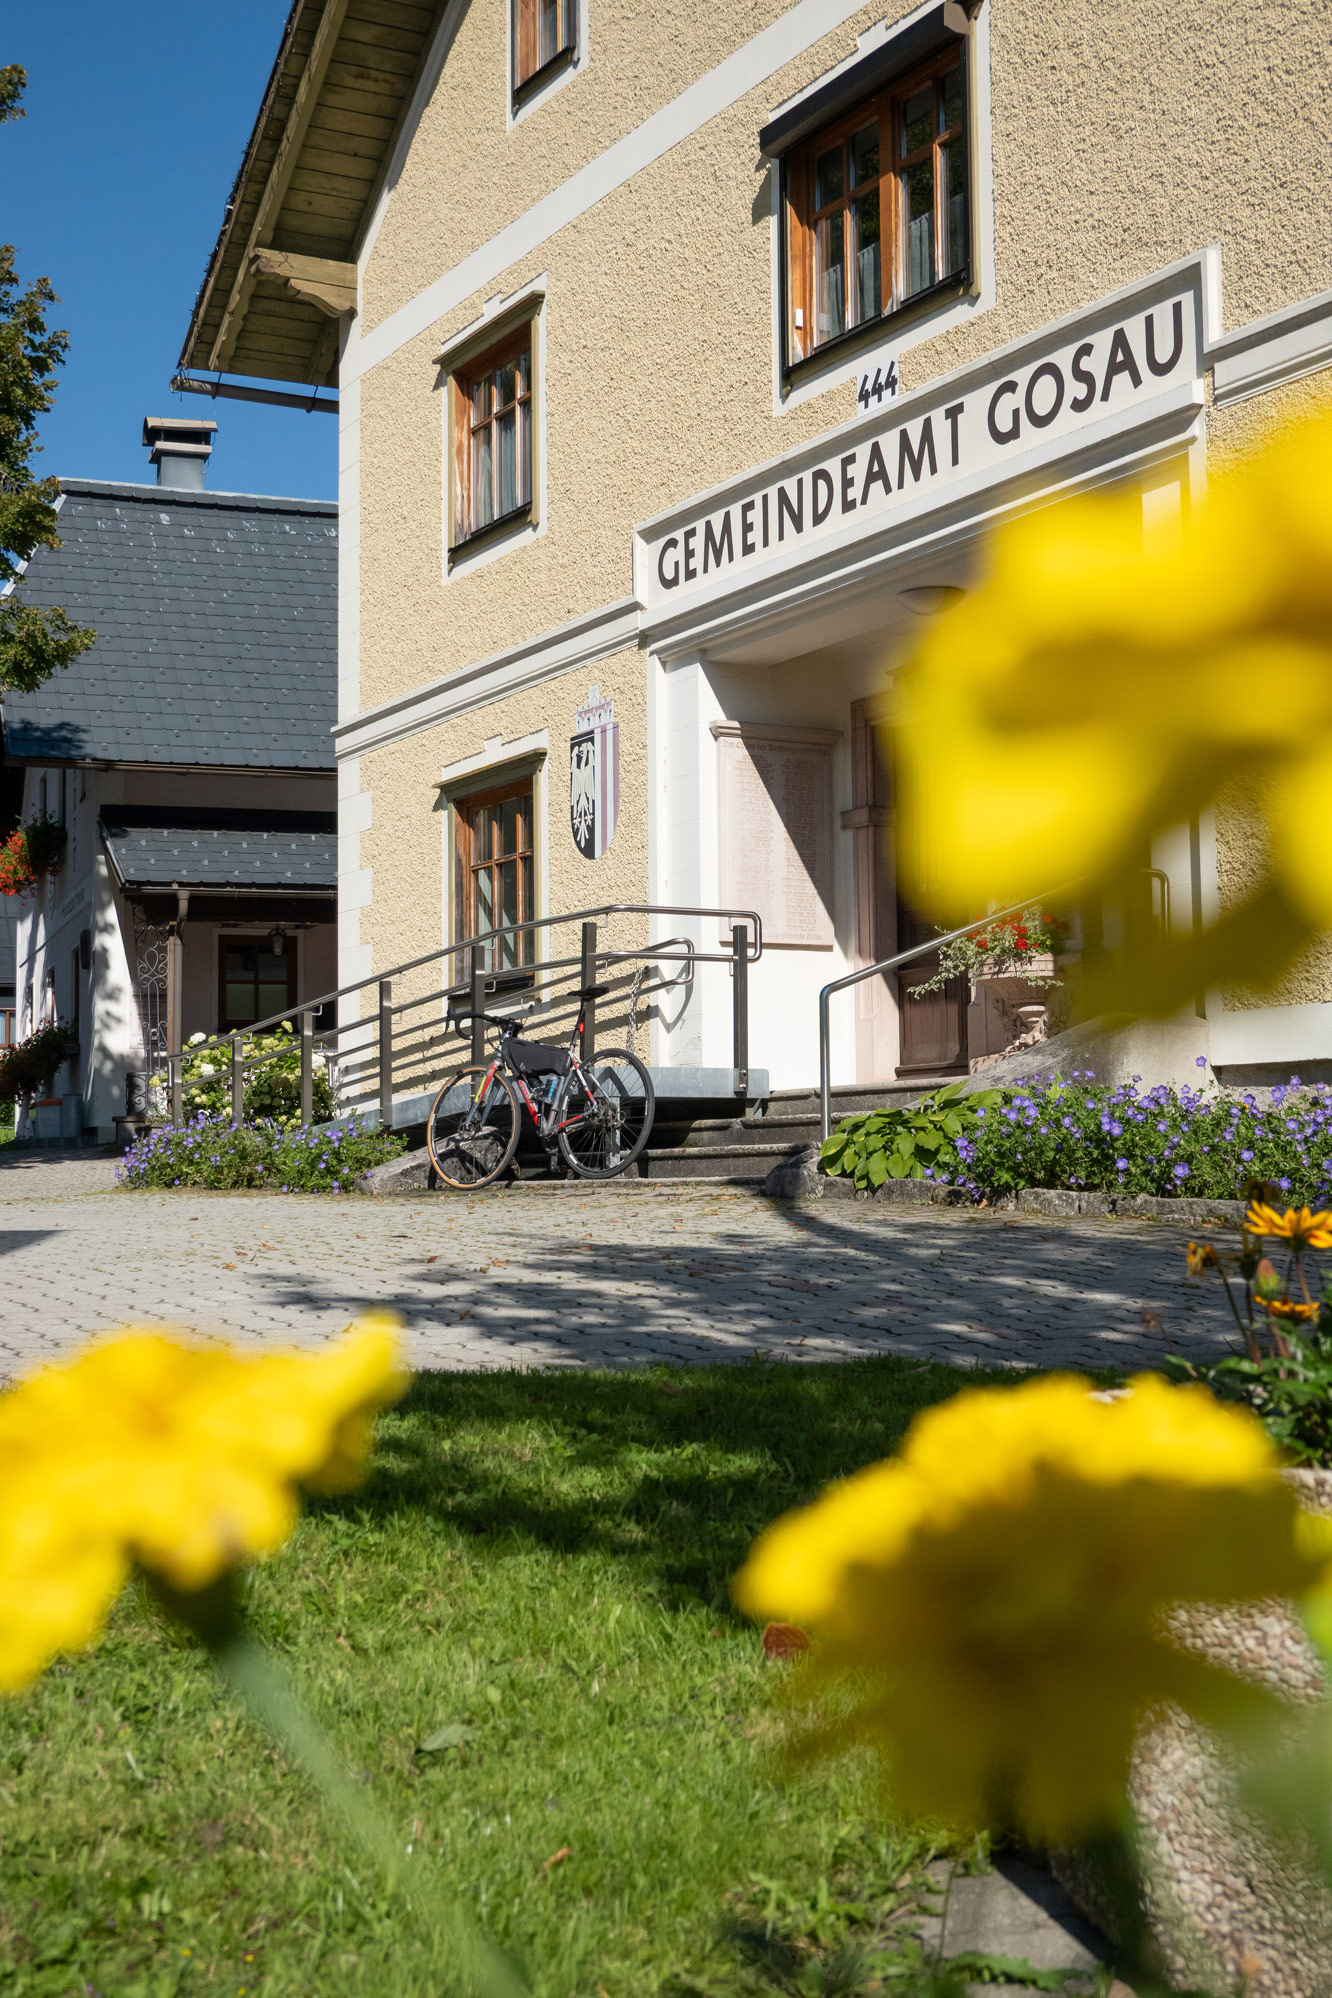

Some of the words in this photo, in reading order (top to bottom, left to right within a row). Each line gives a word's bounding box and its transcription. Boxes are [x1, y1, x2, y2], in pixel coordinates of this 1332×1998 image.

[657, 402, 966, 590] GEMEINDEAMT
[987, 300, 1183, 446] GOSAU
[858, 360, 898, 410] 444
